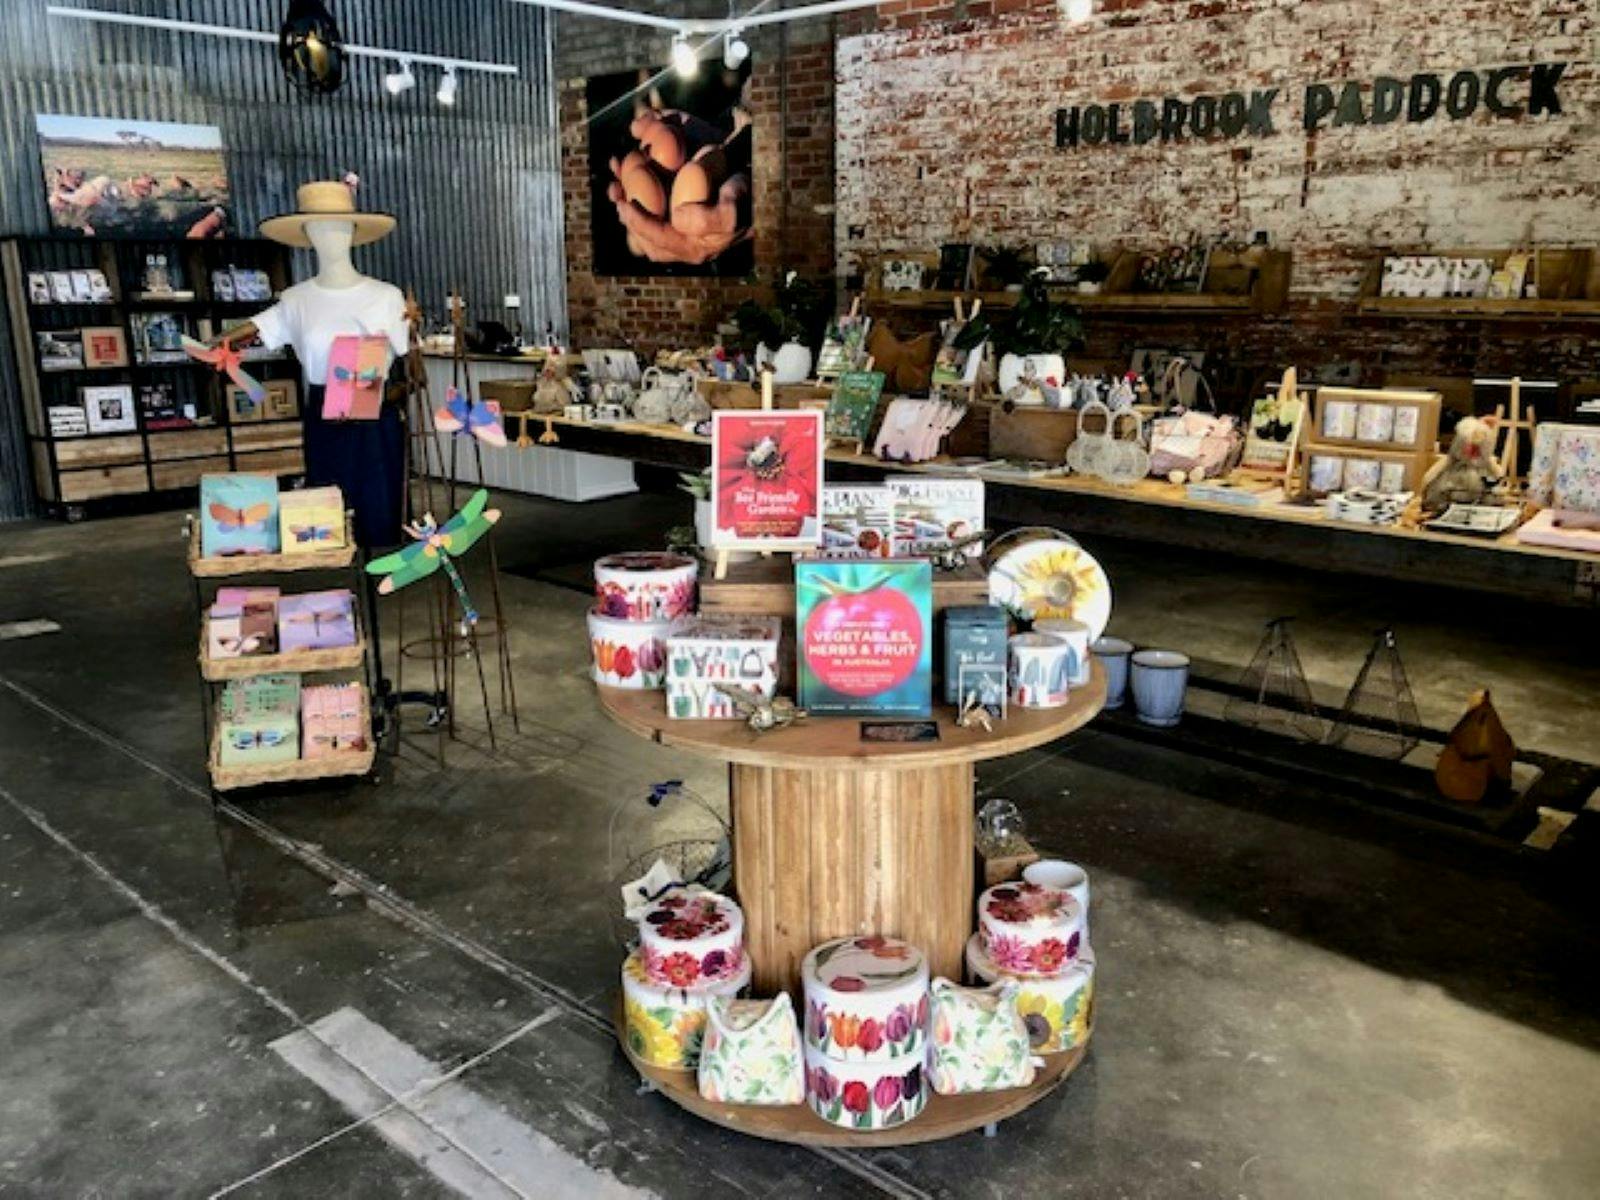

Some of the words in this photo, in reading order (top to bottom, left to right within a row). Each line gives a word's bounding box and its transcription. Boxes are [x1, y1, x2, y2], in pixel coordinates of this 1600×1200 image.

[1055, 89, 1278, 148] HOLBROOK
[1303, 62, 1567, 131] PADDOCK
[756, 490, 801, 505] Friendly
[813, 630, 913, 645] VEGETABLES,
[808, 643, 858, 656] HERBS
[860, 643, 871, 656] &
[873, 643, 918, 656] FRUIT
